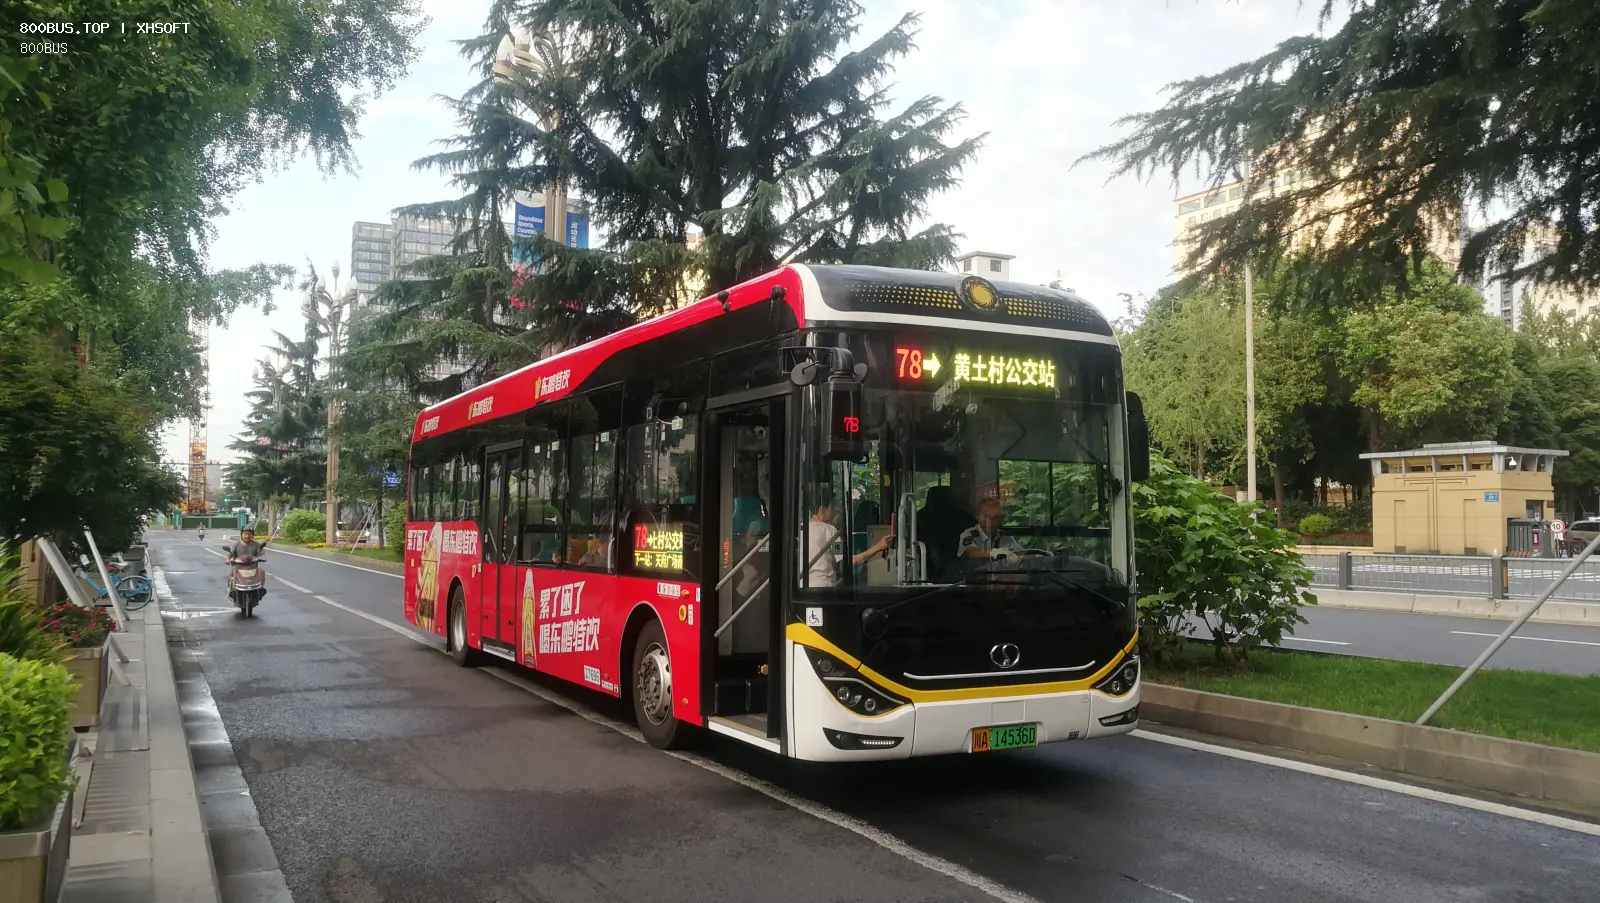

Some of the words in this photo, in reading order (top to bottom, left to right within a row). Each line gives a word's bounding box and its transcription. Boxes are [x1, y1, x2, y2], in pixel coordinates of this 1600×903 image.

[518, 214, 543, 224] Boundless
[896, 348, 922, 379] 78
[953, 352, 1056, 388] 黄土村公交站
[540, 368, 571, 397] 东鹏特饮
[843, 417, 859, 432] 78
[442, 528, 479, 555] 喝东鹏特饮
[635, 525, 648, 549] 78
[539, 580, 586, 620] 累了困了
[539, 616, 601, 654] 喝东鹏特饮
[995, 727, 1036, 748] 14536D
